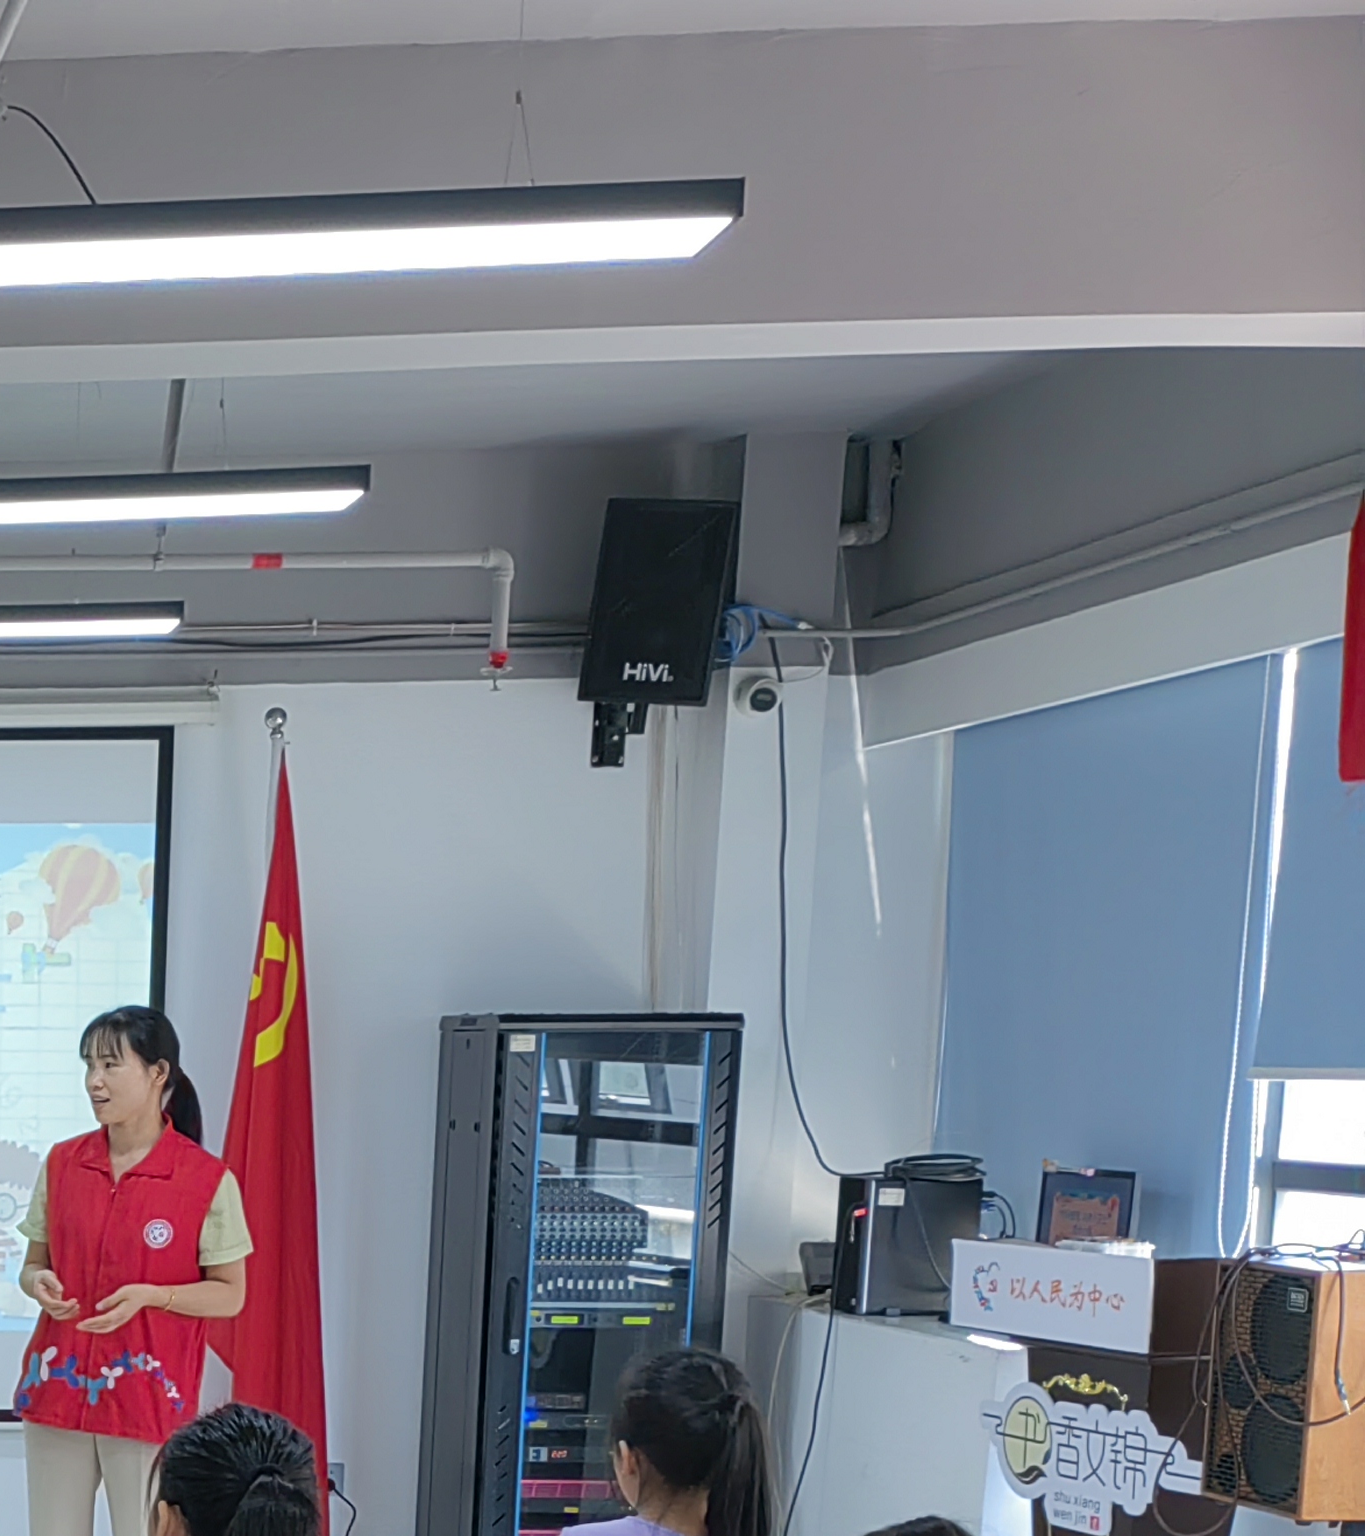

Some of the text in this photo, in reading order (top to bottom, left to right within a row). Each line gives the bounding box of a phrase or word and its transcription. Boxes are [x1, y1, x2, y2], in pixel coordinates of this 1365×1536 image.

[623, 662, 670, 683] HiVi
[1010, 1276, 1125, 1317] 以人民为中心
[1017, 1407, 1147, 1500] 书香文锦
[1054, 1490, 1100, 1514] shu xiang
[1053, 1508, 1087, 1526] wen jin
